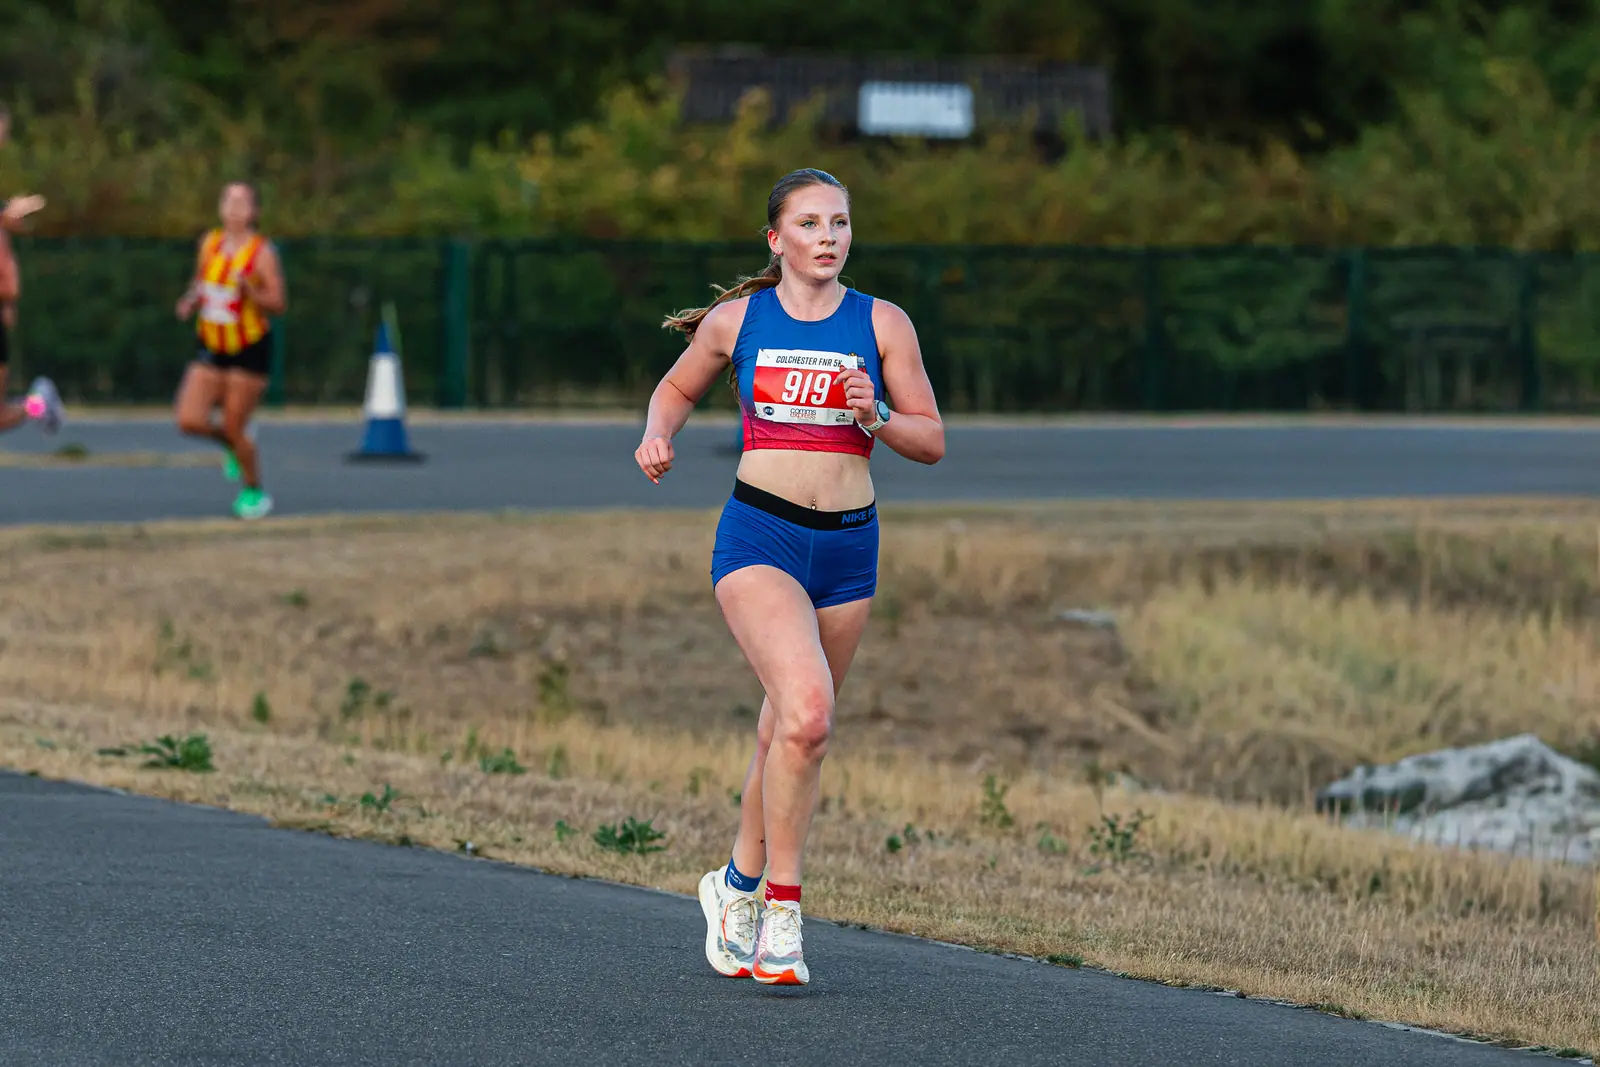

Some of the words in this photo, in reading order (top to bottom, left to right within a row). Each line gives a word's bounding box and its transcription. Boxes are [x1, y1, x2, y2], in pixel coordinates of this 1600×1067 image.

[775, 355, 817, 365] COLCHESTER
[818, 358, 832, 367] FNR
[781, 370, 832, 405] 919
[790, 407, 817, 416] comms
[841, 511, 867, 524] NIKE
